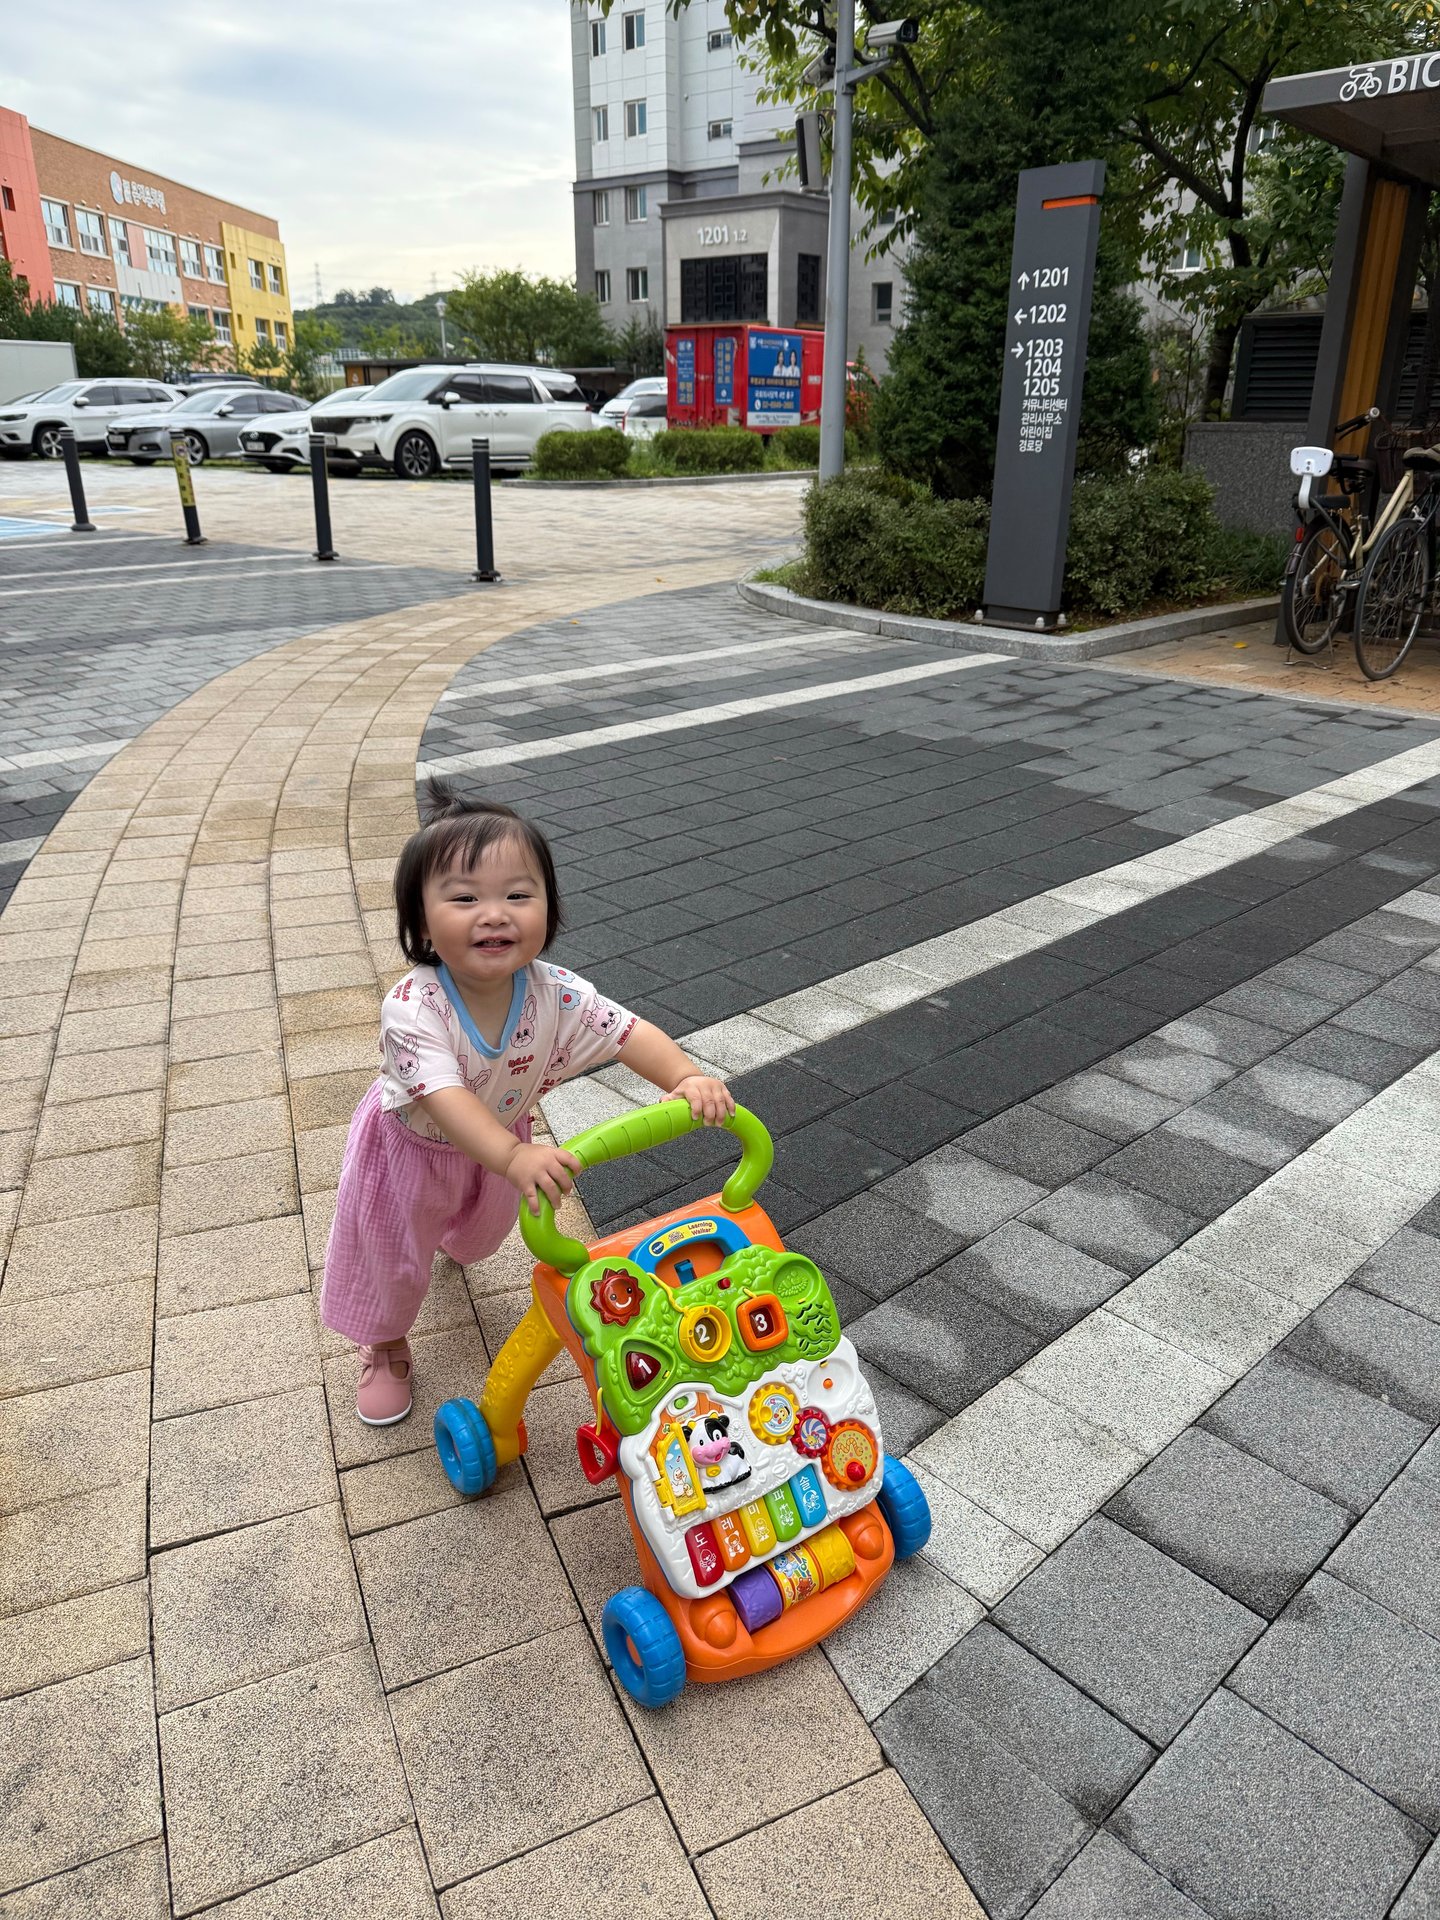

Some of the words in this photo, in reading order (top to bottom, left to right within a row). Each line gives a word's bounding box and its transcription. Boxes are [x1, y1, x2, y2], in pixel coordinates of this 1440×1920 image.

[697, 225, 729, 245] 1201
[733, 229, 747, 242] 1.2
[1032, 266, 1069, 288] 1201
[1029, 303, 1067, 324] 1202
[1026, 338, 1064, 358] 1203
[1025, 358, 1062, 377] 1204
[1023, 378, 1060, 396] 1205
[1022, 398, 1068, 412] 커뮤니티센터
[1021, 412, 1062, 425] 관리사무소
[1020, 426, 1053, 439] 어린이집
[1019, 439, 1043, 453] 경로당
[687, 1221, 713, 1231] Learning
[754, 1313, 768, 1332] 3
[695, 1323, 710, 1344] 2
[638, 1358, 652, 1375] 1
[799, 1476, 811, 1491] 솔
[772, 1488, 785, 1501] 파
[747, 1503, 760, 1516] 미
[720, 1516, 734, 1531] 레
[694, 1532, 708, 1548] 도
